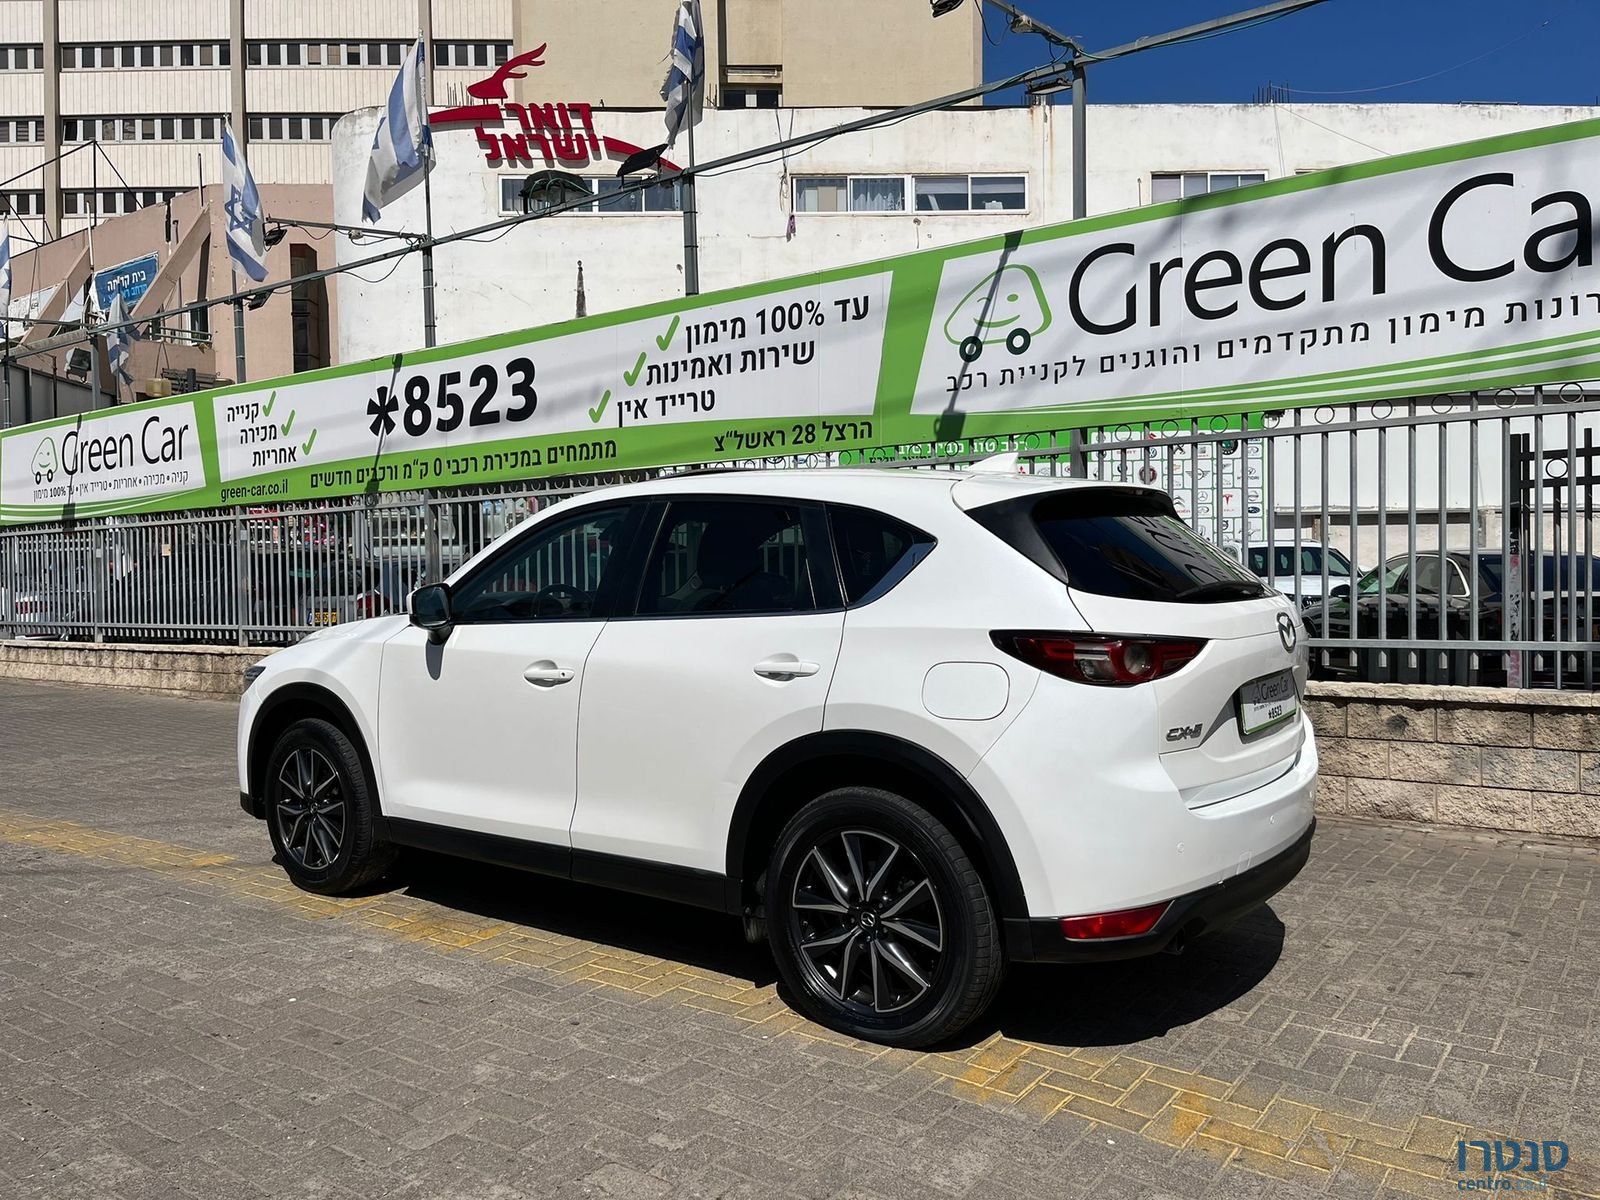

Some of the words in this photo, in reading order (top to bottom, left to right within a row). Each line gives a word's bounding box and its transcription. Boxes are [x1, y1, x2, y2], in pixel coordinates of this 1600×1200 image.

[504, 103, 595, 130] דואר
[475, 126, 600, 161] ישראל
[131, 270, 147, 284] בית
[1067, 222, 1387, 337] Green
[756, 300, 825, 336] 100%
[834, 295, 870, 323] עד
[685, 317, 746, 354] מימון
[1388, 306, 1486, 346] מימון
[1217, 321, 1370, 361] מתקדמים
[739, 340, 815, 373] שירות
[1099, 342, 1202, 376] והוגנים
[646, 352, 732, 386] ואמינות
[998, 354, 1087, 388] לקניית
[945, 373, 988, 393] רכב
[227, 402, 259, 423] קנייה
[616, 398, 648, 428] אין
[655, 389, 715, 417] טרייד
[239, 424, 278, 445] מכירה
[792, 424, 816, 445] 28
[822, 421, 873, 442] הרצל
[62, 430, 134, 476] Green
[141, 416, 190, 465] Car
[252, 445, 297, 467] אחריות
[547, 439, 617, 465] מתמחים
[433, 457, 442, 477] 0
[447, 456, 479, 476] רכבי
[483, 451, 542, 472] במכירת
[113, 476, 138, 490] אחריות
[143, 473, 165, 487] מכירה
[171, 470, 189, 485] קניה
[310, 468, 352, 489] חדשים
[356, 463, 398, 484] ורכבים
[33, 488, 49, 502] מימון
[49, 485, 66, 498] 100%
[79, 482, 89, 496] אין
[90, 480, 108, 492] טרייד
[220, 479, 288, 502] green-car.co.il
[1166, 723, 1203, 742] CX-5
